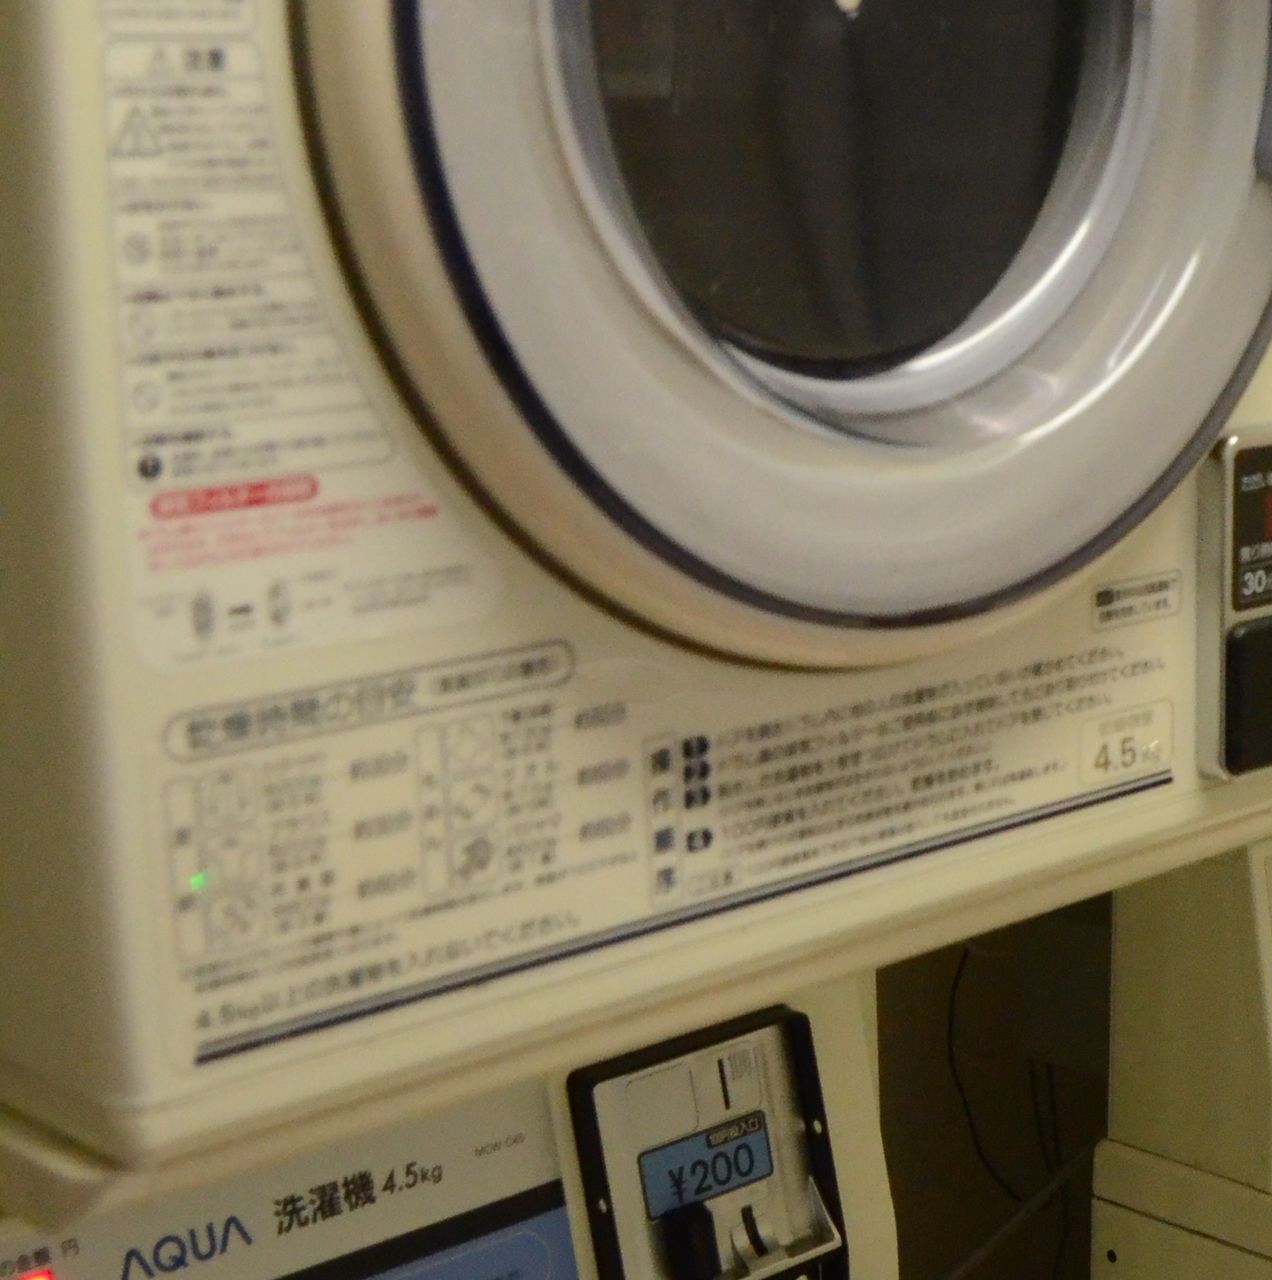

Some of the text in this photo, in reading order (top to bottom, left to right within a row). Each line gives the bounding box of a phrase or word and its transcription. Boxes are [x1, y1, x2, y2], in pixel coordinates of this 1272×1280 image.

[273, 1161, 443, 1236] 洗濯機 4.5kg
[668, 1143, 756, 1205] ¥200
[61, 1237, 80, 1259] 円
